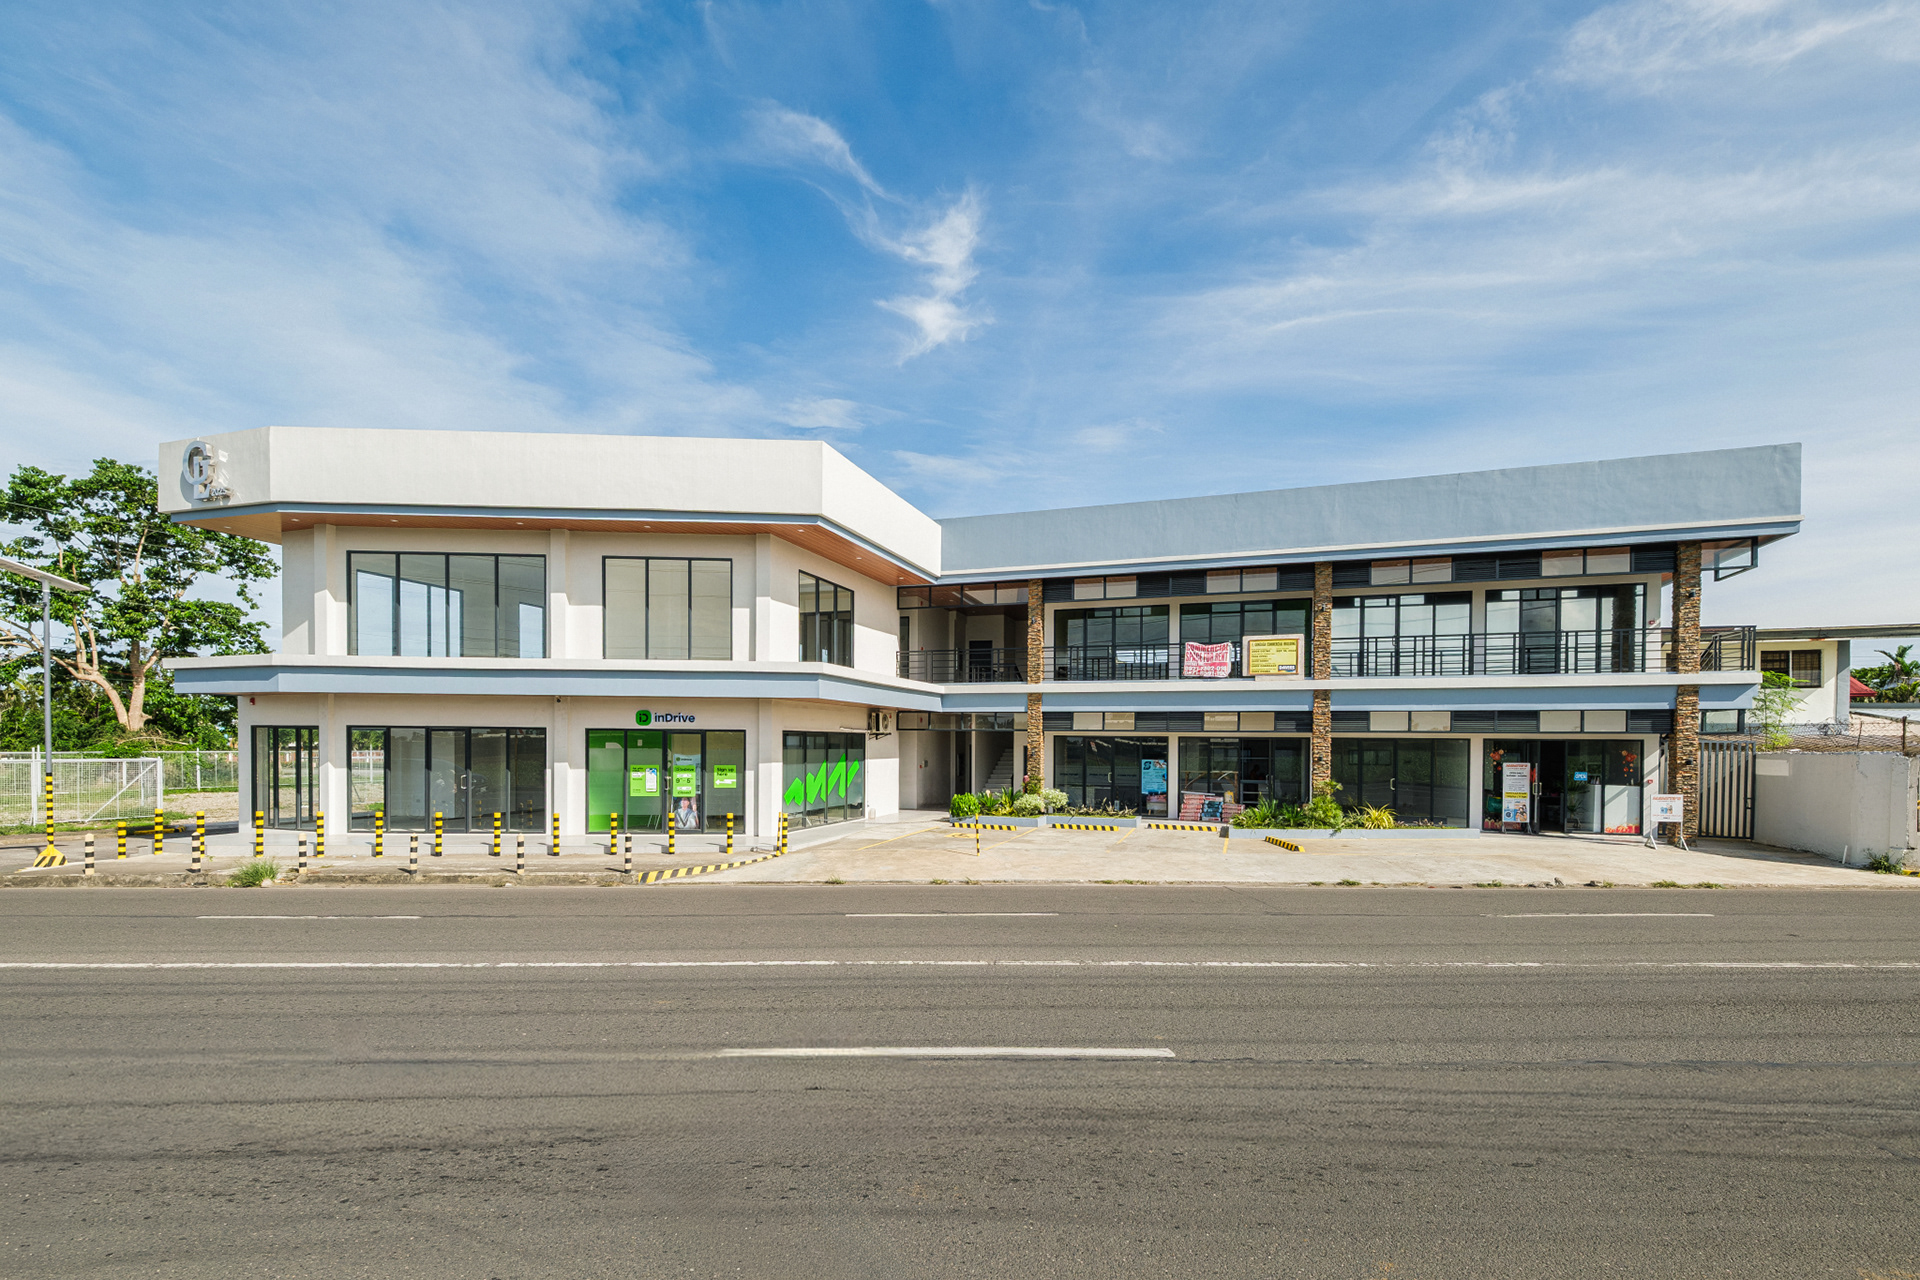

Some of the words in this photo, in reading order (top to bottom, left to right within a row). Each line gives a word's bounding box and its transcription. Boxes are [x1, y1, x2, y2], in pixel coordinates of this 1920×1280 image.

[1186, 642, 1229, 652] COMMERCIAL
[1186, 652, 1202, 662] SPACE
[1203, 653, 1214, 662] FOR
[1215, 652, 1228, 661] RENT
[654, 712, 695, 722] inDrive
